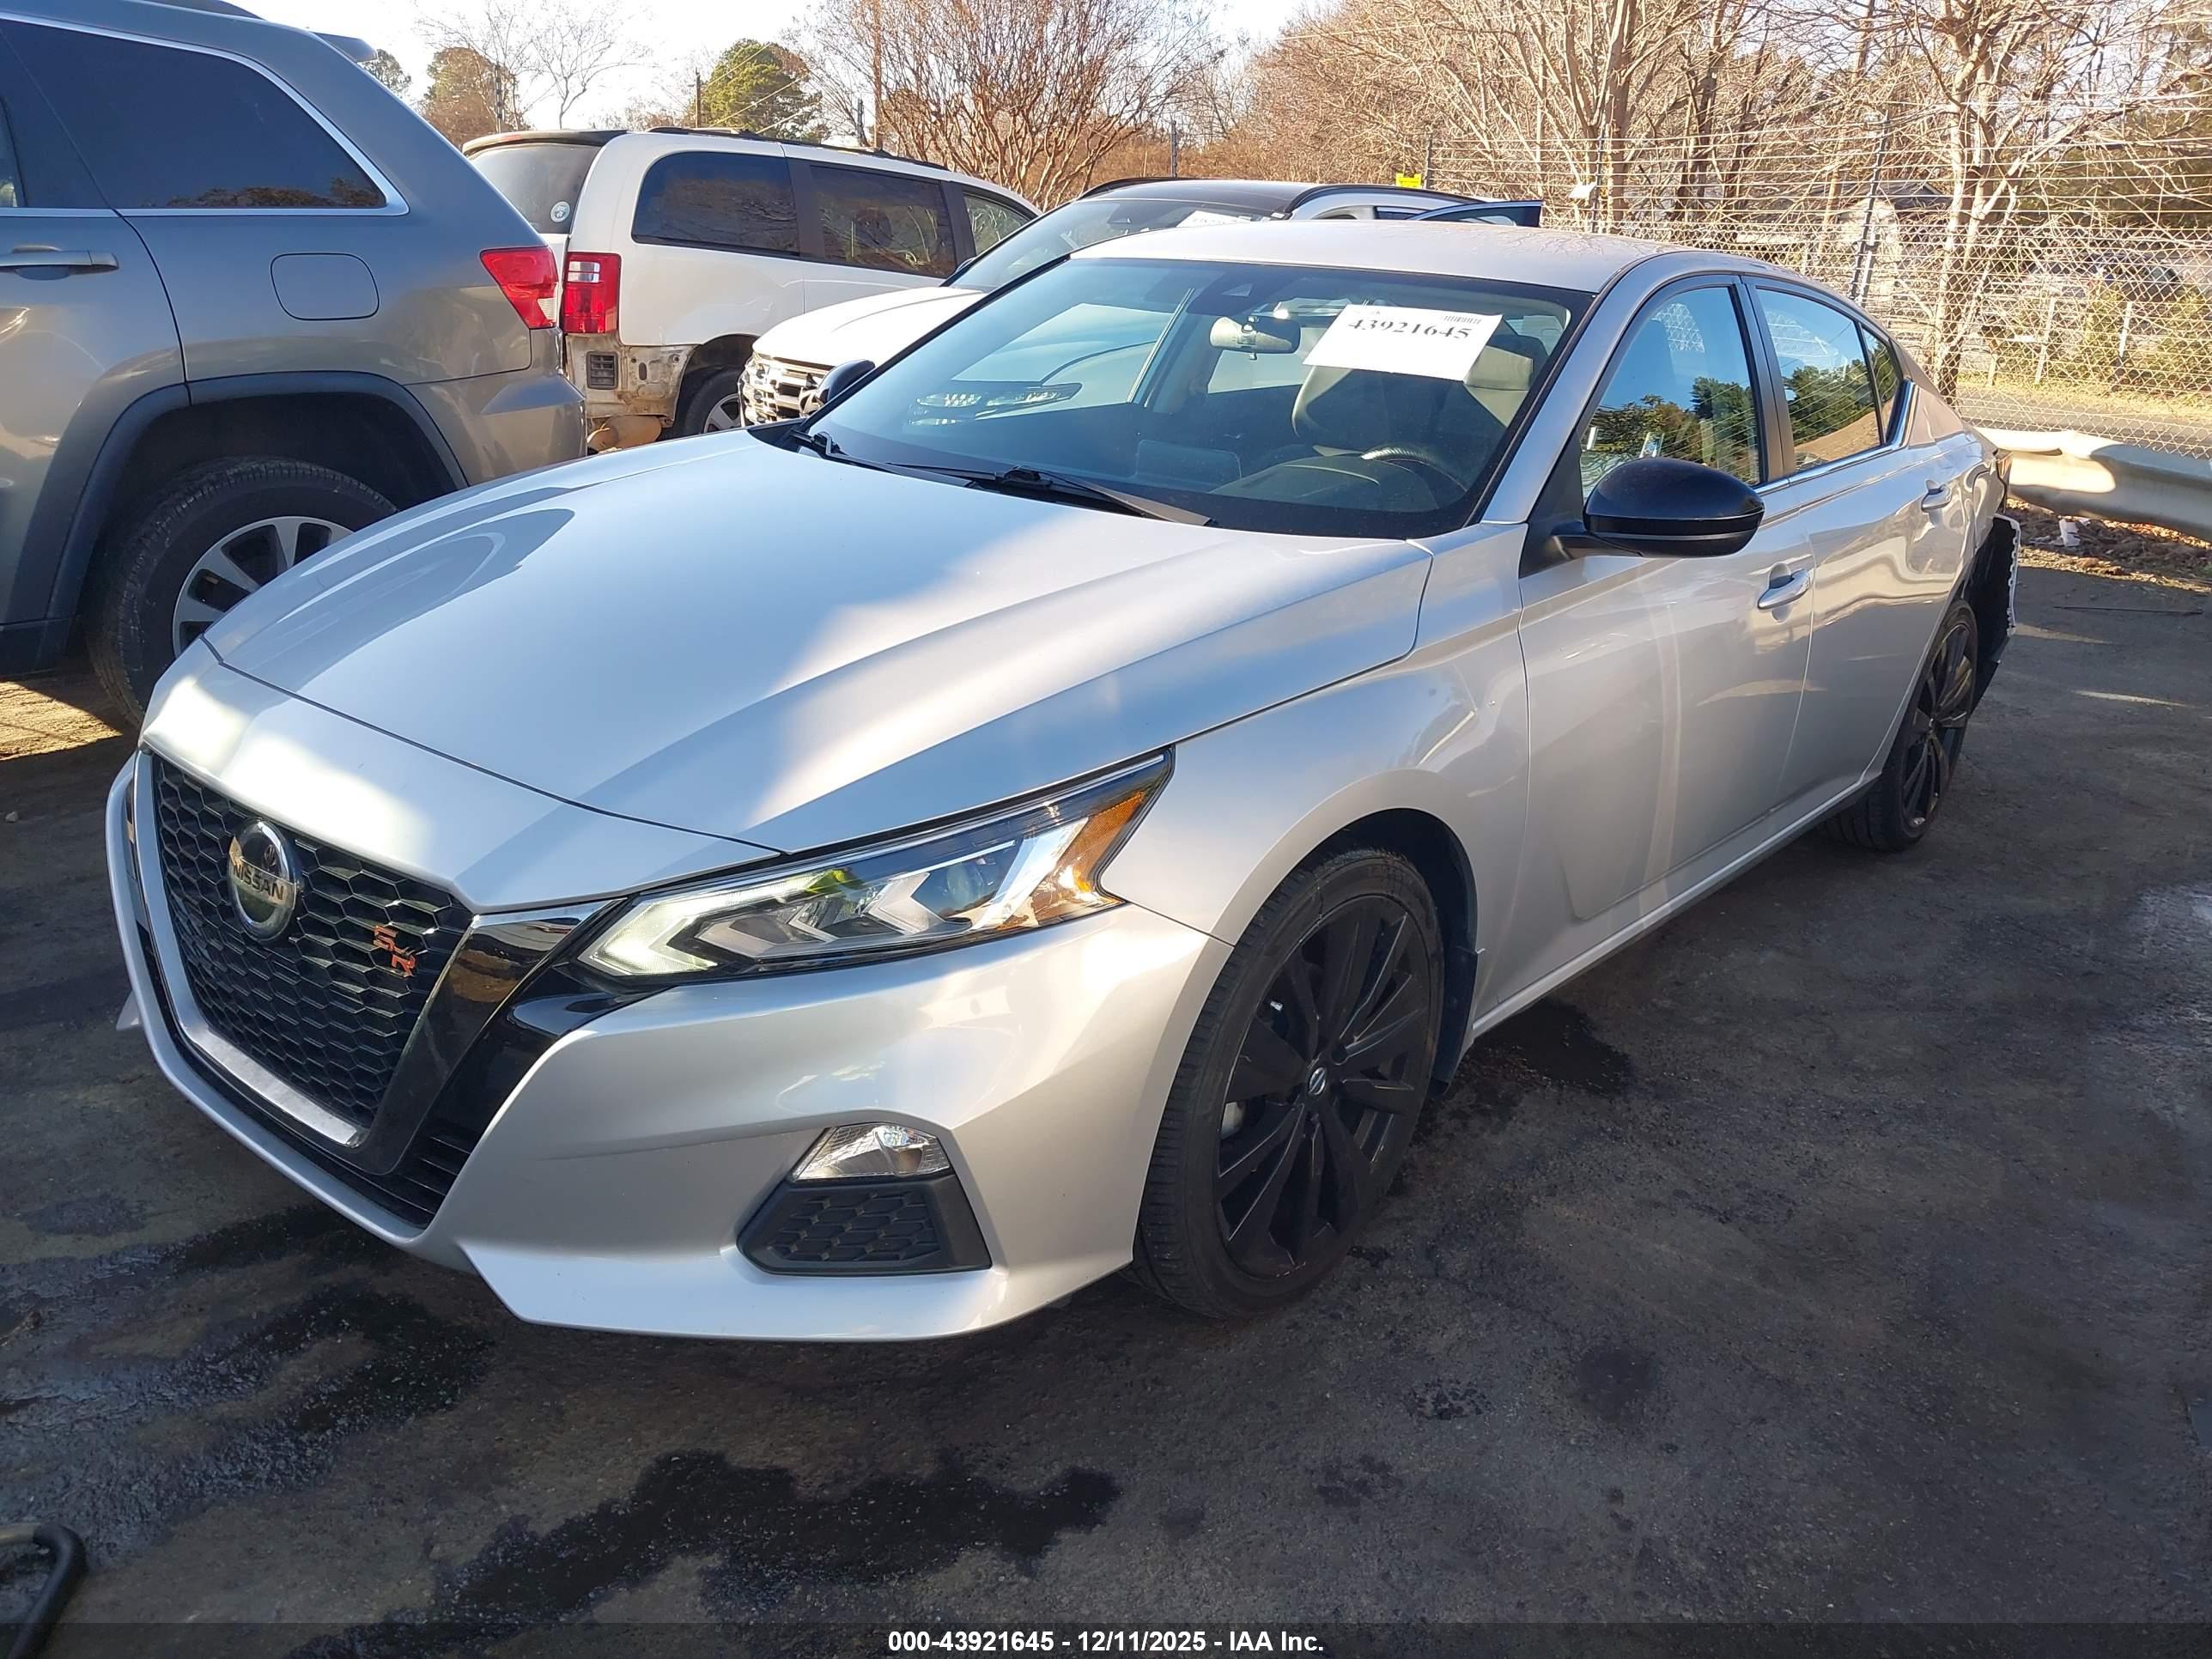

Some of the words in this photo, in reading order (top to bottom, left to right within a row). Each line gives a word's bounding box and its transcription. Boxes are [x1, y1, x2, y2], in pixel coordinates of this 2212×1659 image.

[1348, 319, 1474, 339] 43921645
[233, 864, 284, 901] NISSAN
[373, 926, 416, 977] SR
